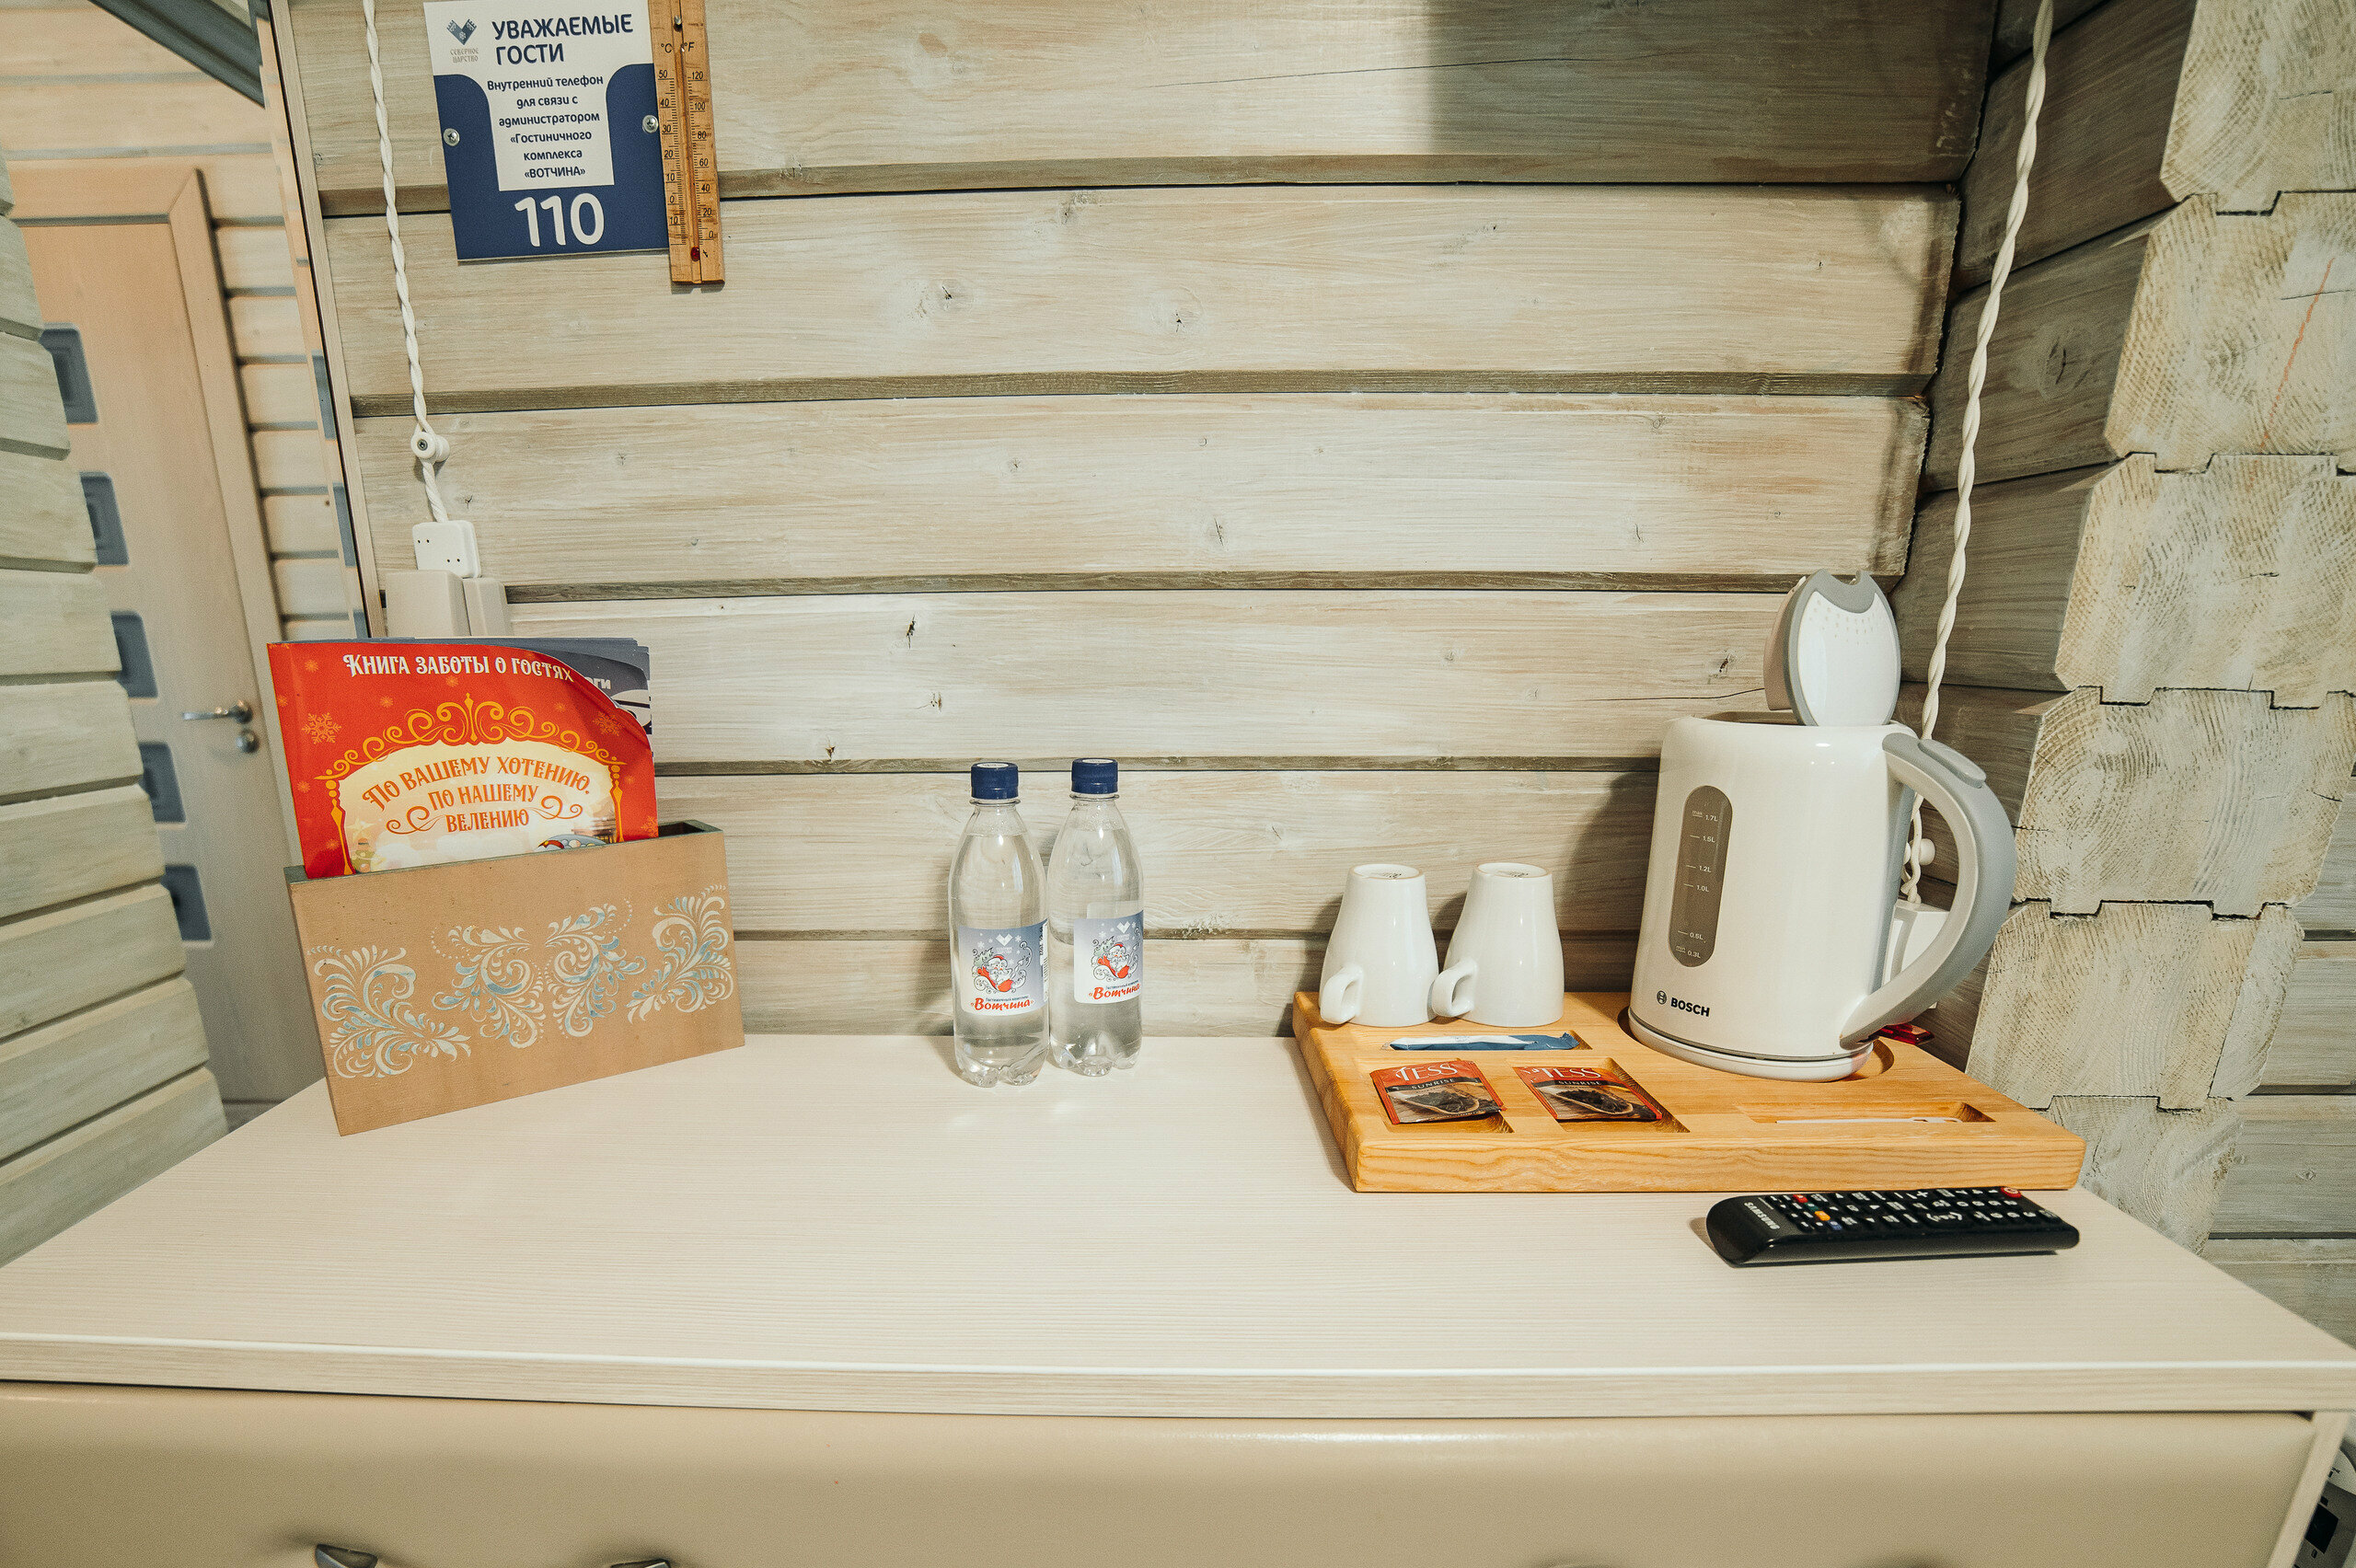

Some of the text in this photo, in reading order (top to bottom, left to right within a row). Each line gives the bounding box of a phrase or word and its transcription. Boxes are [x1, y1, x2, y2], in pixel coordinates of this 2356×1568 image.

[491, 14, 633, 40] УВАЖАЕМЫЕ
[496, 43, 564, 65] ГОСТИ
[659, 70, 668, 78] 50
[692, 71, 704, 80] 120
[487, 75, 604, 92] Внутренний телефон
[516, 96, 578, 109] для связи с
[660, 98, 669, 107] 40
[695, 102, 706, 110] 100
[499, 112, 600, 128] администратором
[662, 124, 671, 133] 30
[510, 132, 592, 144] «Гостиничного
[698, 131, 707, 139] 80
[524, 150, 583, 160] комплекса
[664, 150, 674, 158] 20
[699, 157, 709, 167] 60
[525, 166, 585, 178] «ВОТЧИНА»
[666, 173, 675, 181] 10
[701, 184, 710, 192] 40
[669, 195, 675, 203] 0
[703, 208, 711, 216] 20
[514, 192, 605, 247] 110
[669, 216, 678, 225] 10
[709, 230, 713, 238] 0
[415, 655, 491, 674] ЗАБОТЫ
[495, 656, 507, 674] О
[511, 657, 574, 683] ГОСТЯХ
[398, 756, 491, 790] ВАШЕМУ
[428, 783, 539, 811] ПО НАШЕМУ
[445, 809, 529, 833] ВЕЛЕНИЮ
[1699, 865, 1711, 873] 1.2L
[1696, 884, 1709, 893] 1.0L
[1670, 997, 1710, 1017] BOSCH
[1395, 1063, 1458, 1080] TESS
[1532, 1067, 1601, 1078] TESS
[1412, 1078, 1455, 1090] SUNRISE
[1744, 1202, 1780, 1229] SAMSUNG
